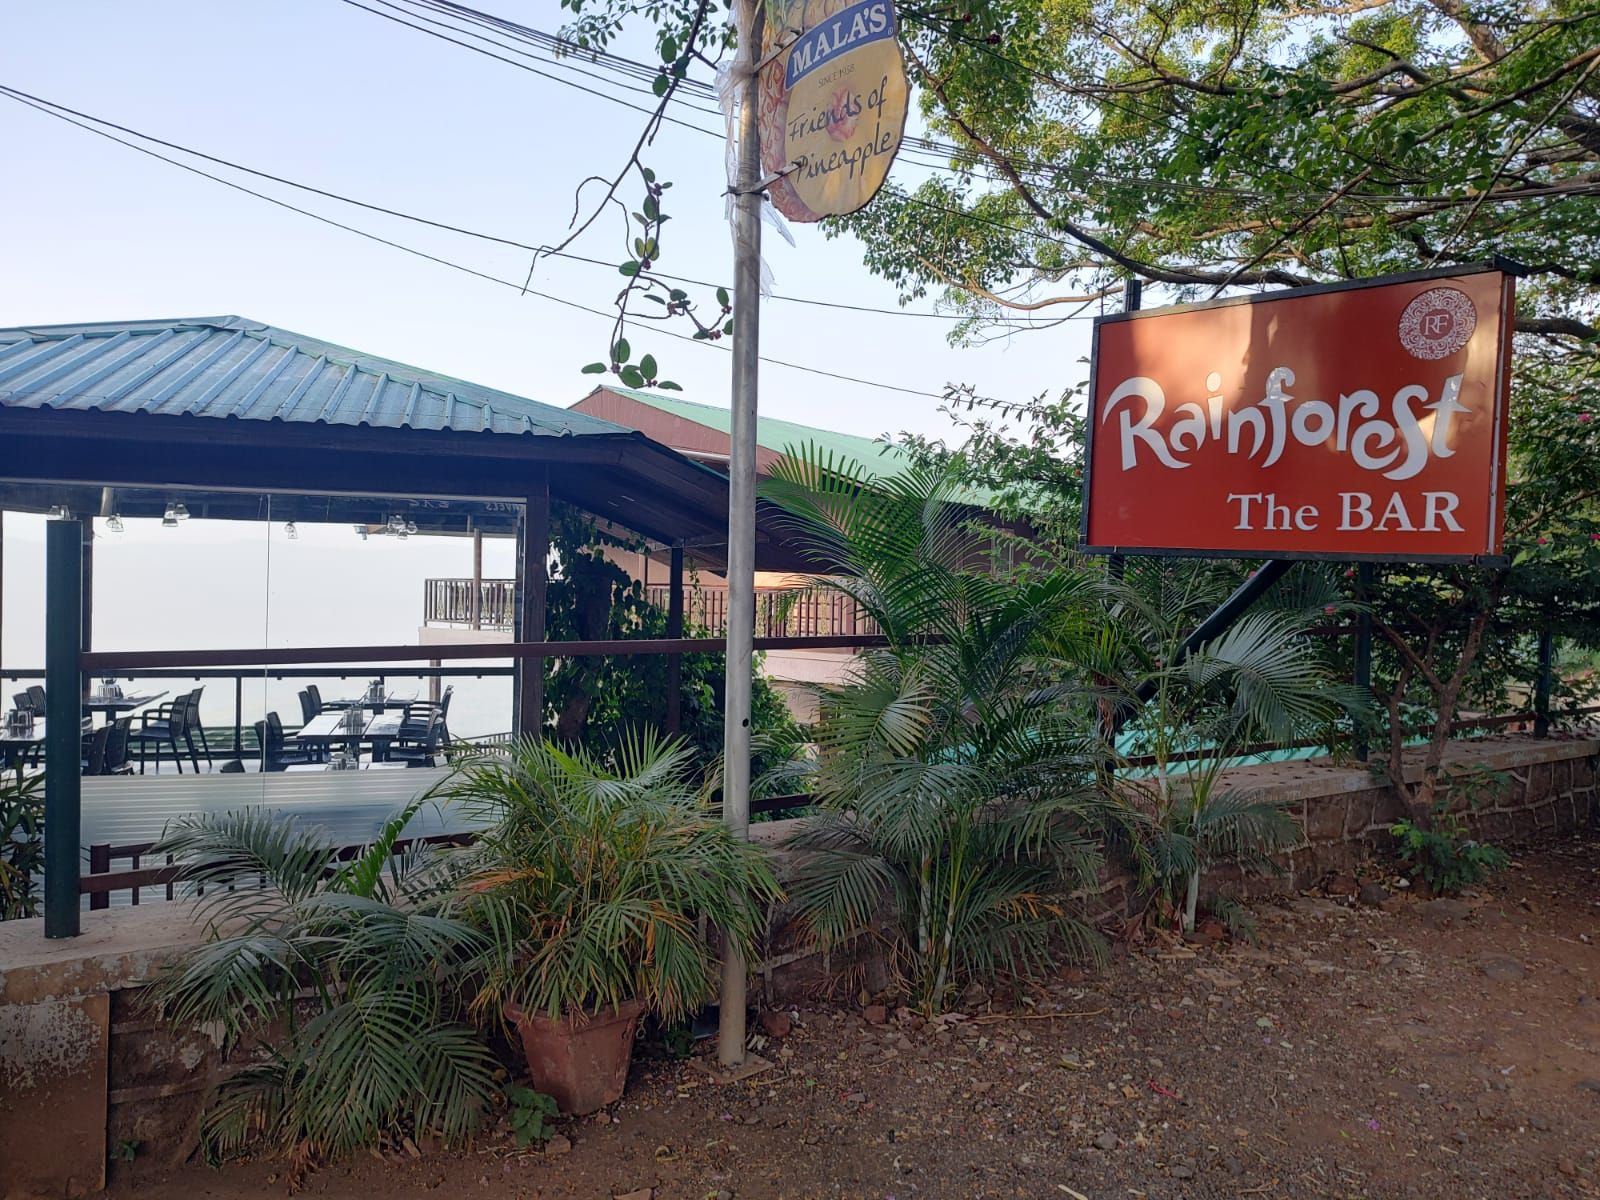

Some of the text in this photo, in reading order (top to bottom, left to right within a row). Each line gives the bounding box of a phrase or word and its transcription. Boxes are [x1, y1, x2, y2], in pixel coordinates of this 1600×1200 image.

[791, 3, 887, 77] MALA'S
[788, 75, 888, 142] Friends of
[795, 121, 894, 184] Pineapple
[1423, 313, 1449, 336] RF
[1102, 366, 1472, 481] Rainforest
[1226, 491, 1465, 532] The BAR
